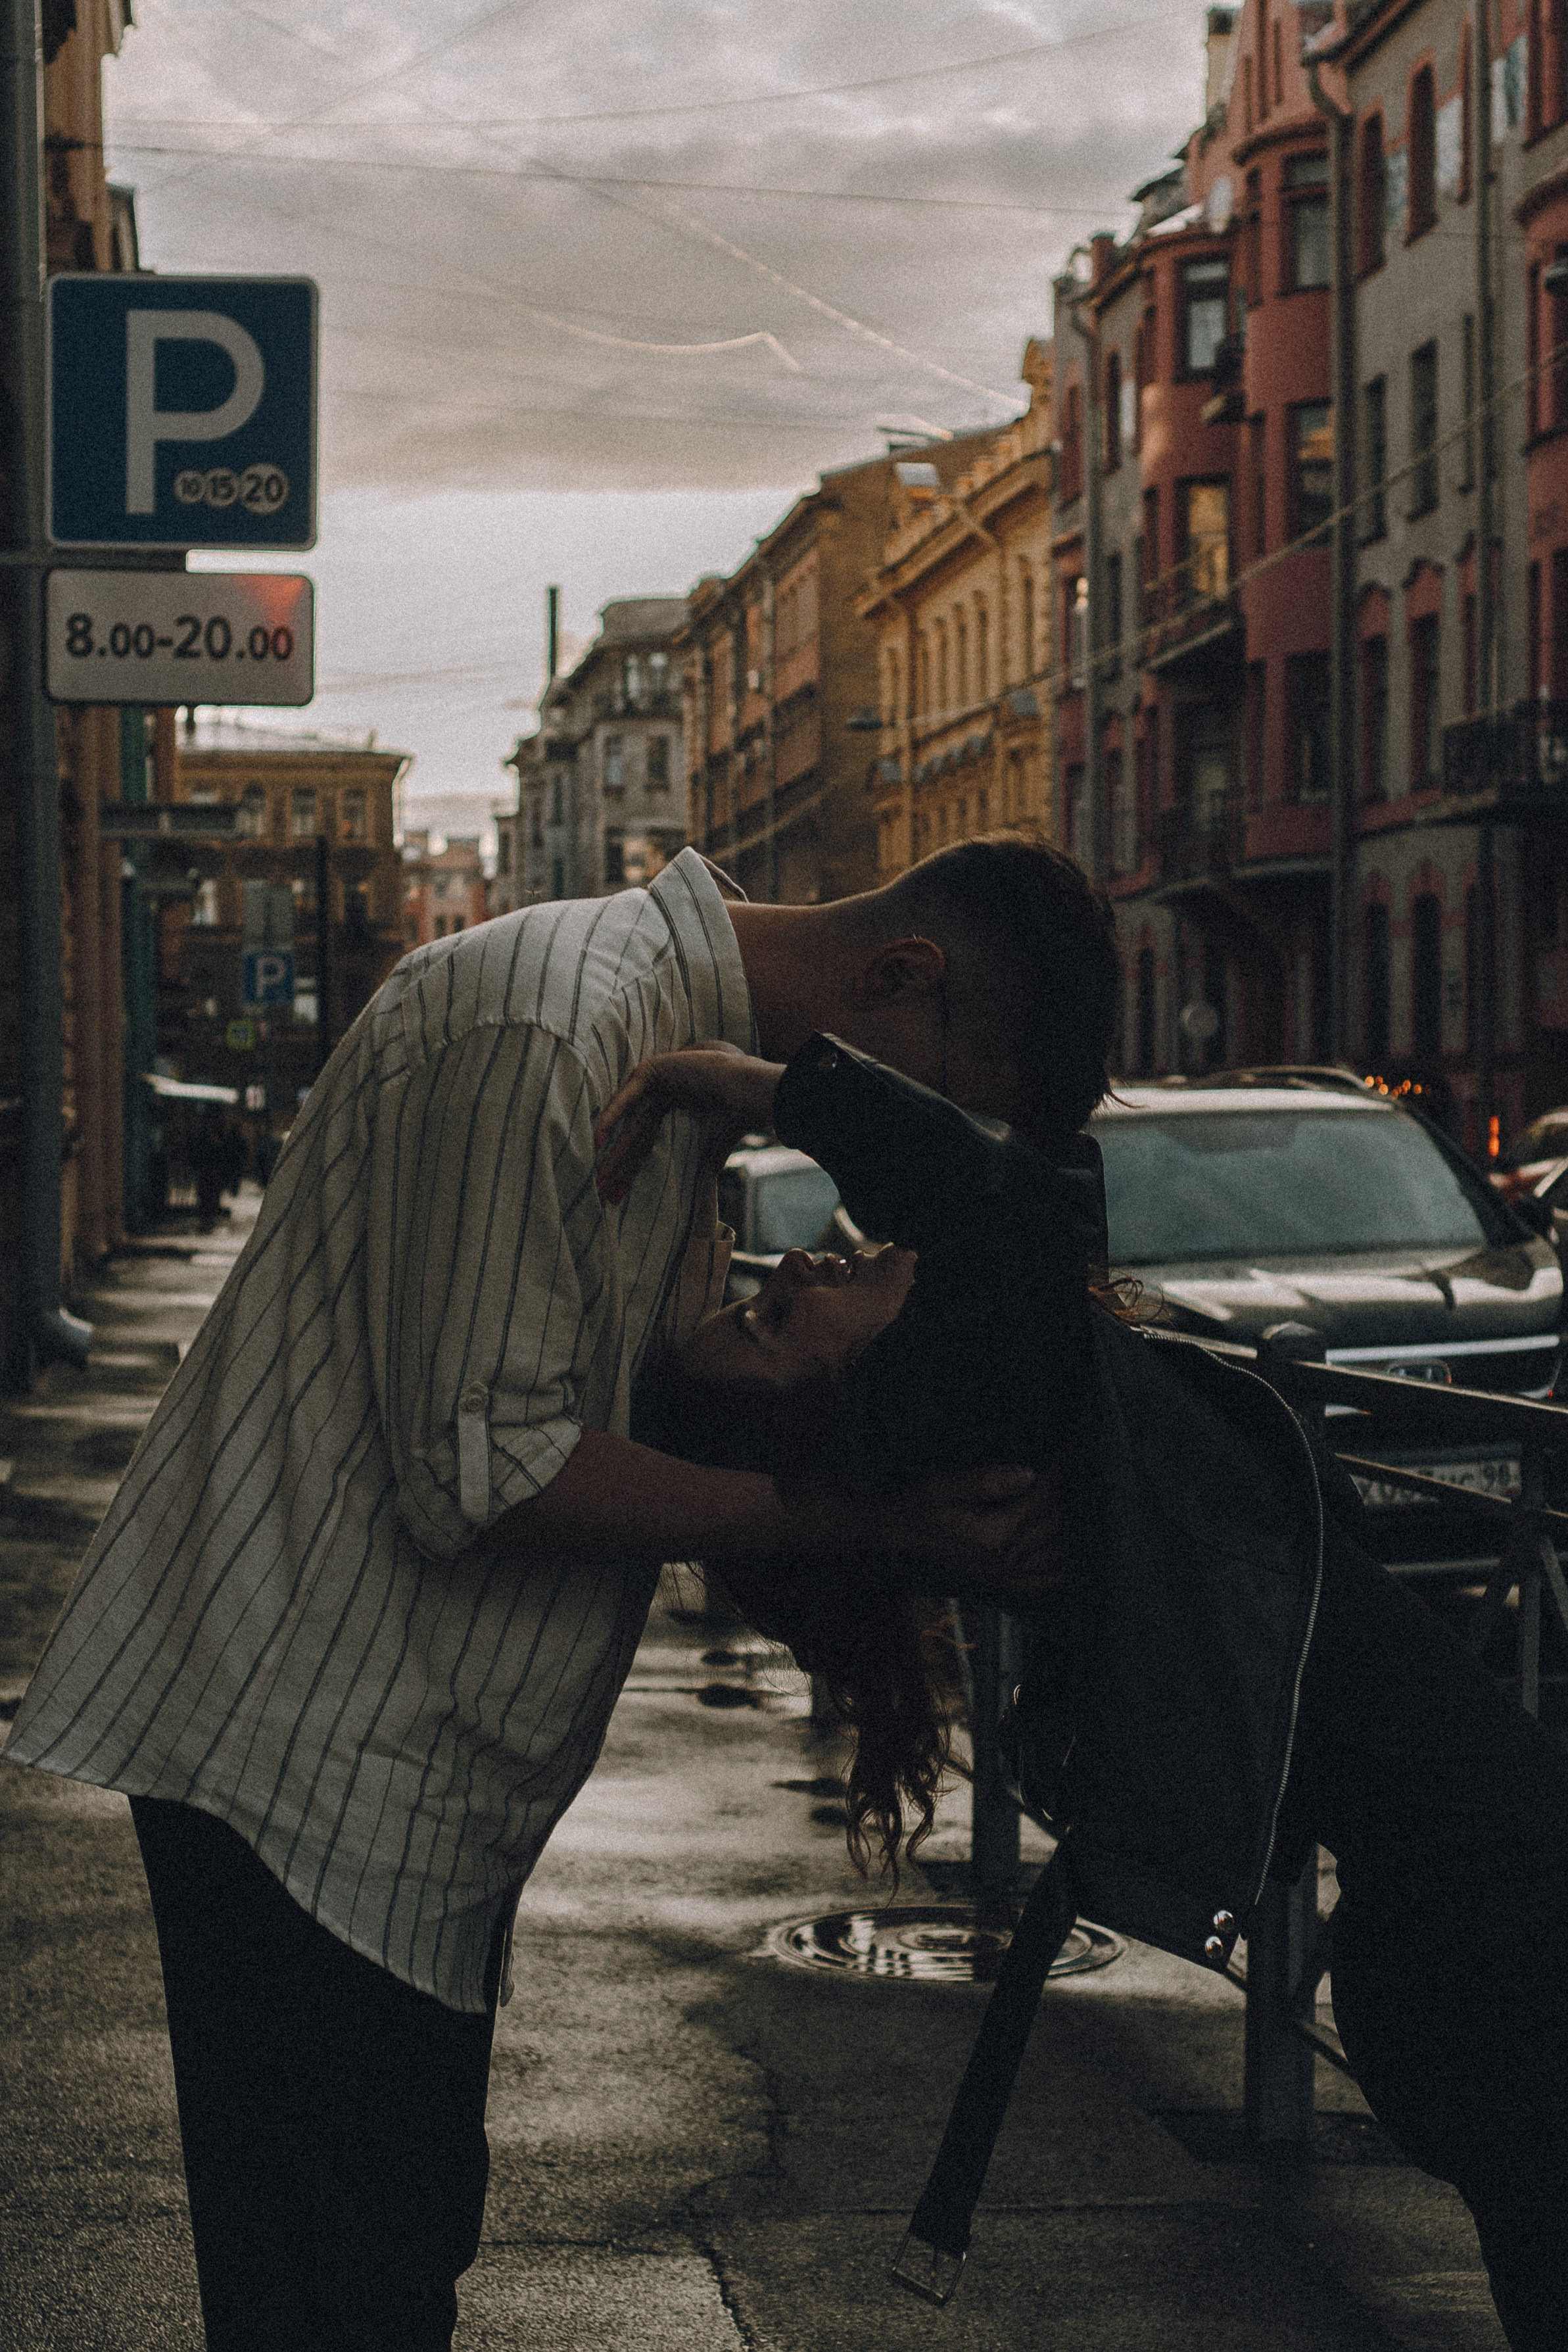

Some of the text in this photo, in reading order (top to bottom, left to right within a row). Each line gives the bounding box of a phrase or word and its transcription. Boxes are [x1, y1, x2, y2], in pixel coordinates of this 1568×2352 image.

[126, 308, 265, 515] P
[210, 475, 233, 499] 15
[246, 473, 283, 503] 20
[66, 612, 294, 661] 8.00-20.00
[256, 955, 286, 998] P
